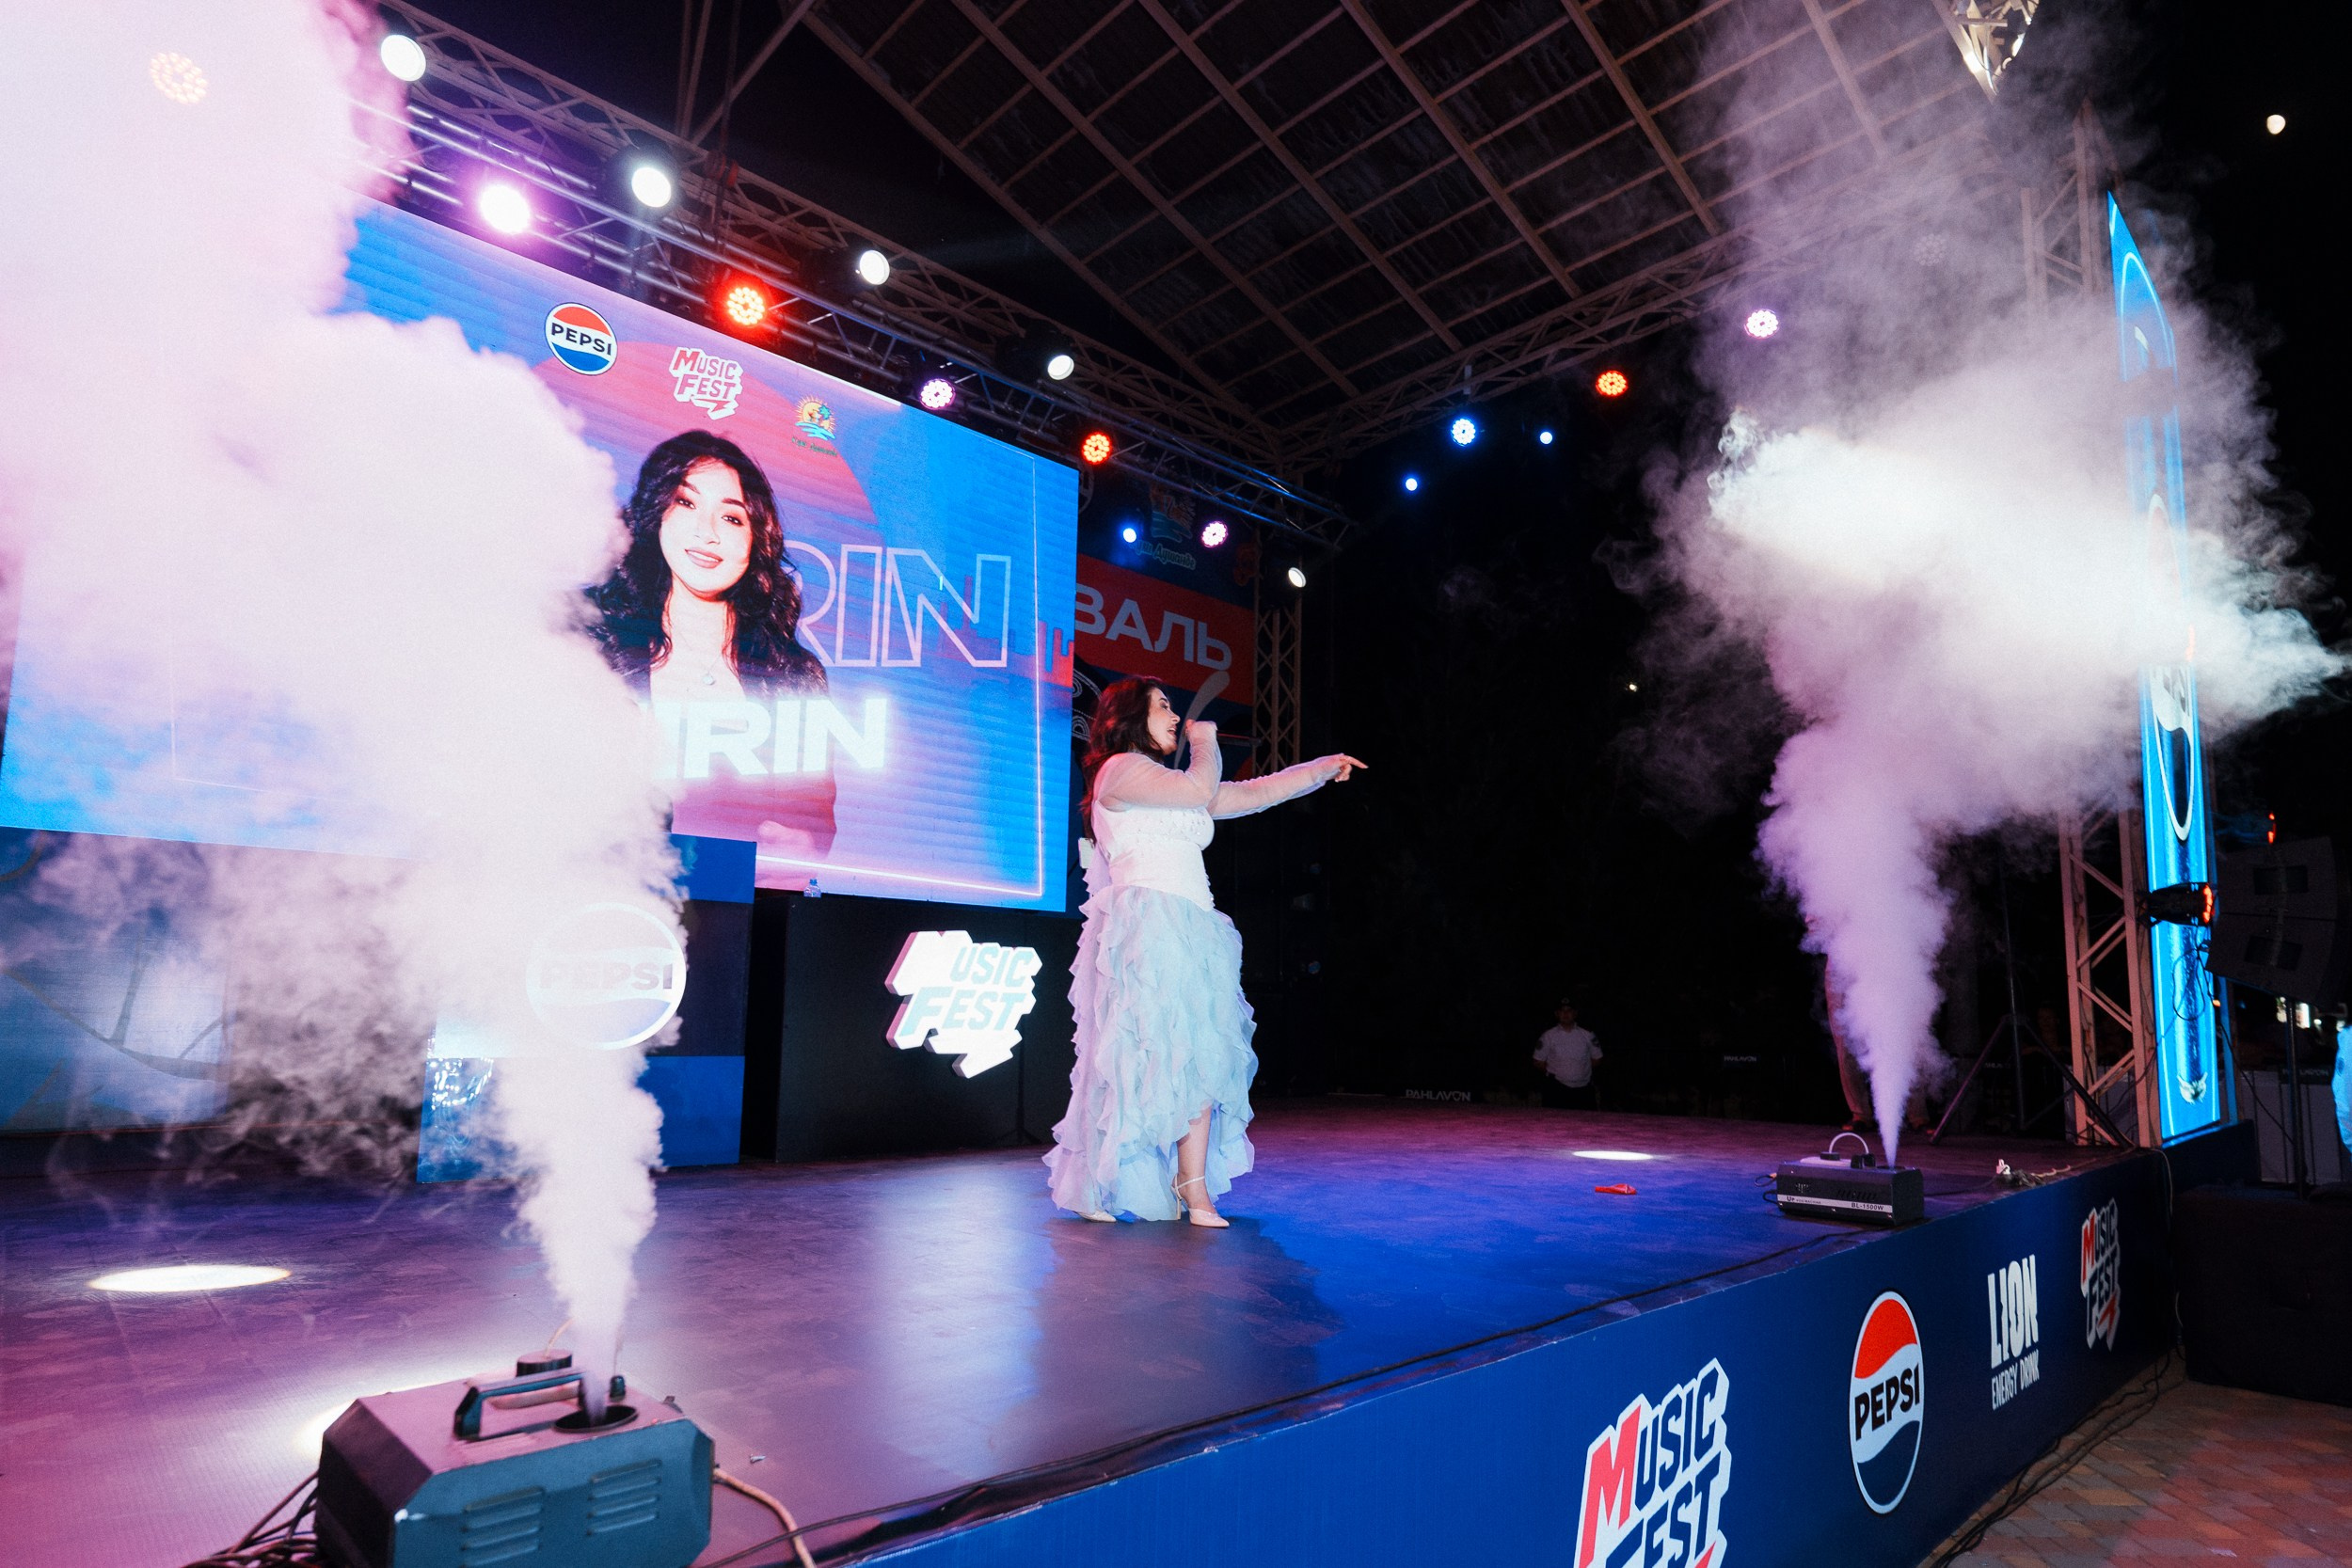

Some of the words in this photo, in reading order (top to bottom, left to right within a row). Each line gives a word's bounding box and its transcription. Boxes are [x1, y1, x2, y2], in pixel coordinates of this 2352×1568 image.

[551, 322, 612, 356] PEPSI
[673, 350, 738, 379] MUSIC
[677, 373, 737, 399] FEST
[1074, 583, 1232, 672] ВАЛЬ
[898, 987, 1027, 1037] FEST
[1406, 1089, 1471, 1101] PAHLAVON
[1851, 1202, 1884, 1211] BL-1500W
[2081, 1201, 2118, 1284] MUSIC
[1987, 1254, 2039, 1370] LION
[2088, 1245, 2118, 1343] FEST
[1854, 1362, 1920, 1442] PEPSI
[1991, 1362, 2018, 1411] ENERGY
[2020, 1349, 2040, 1391] DRINK
[1579, 1367, 1720, 1568] MUSIC
